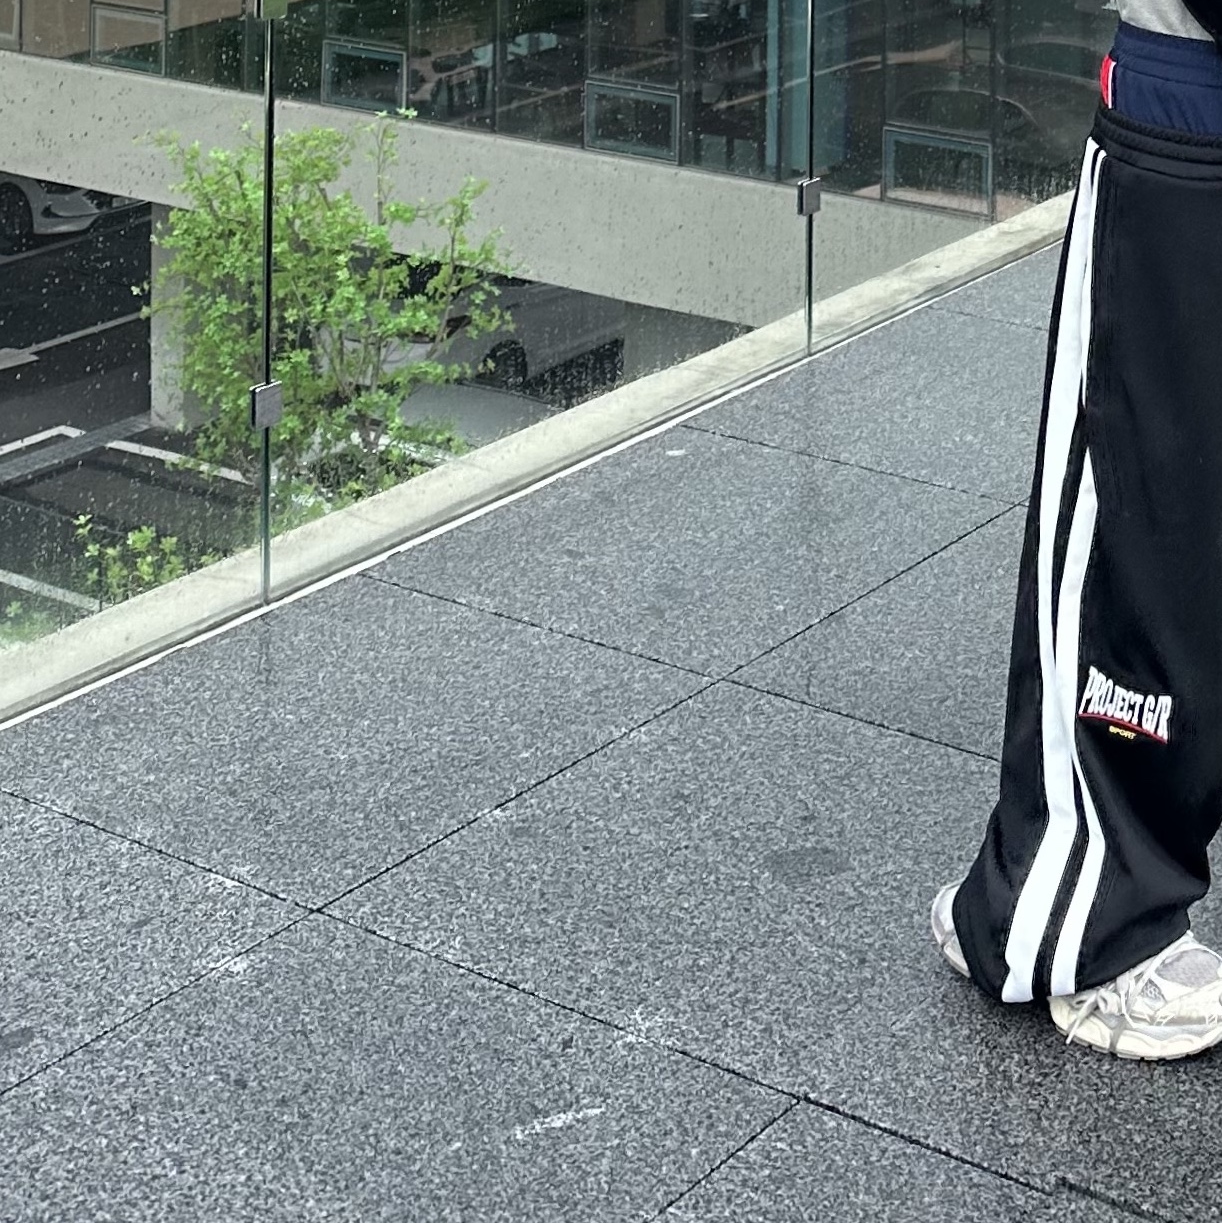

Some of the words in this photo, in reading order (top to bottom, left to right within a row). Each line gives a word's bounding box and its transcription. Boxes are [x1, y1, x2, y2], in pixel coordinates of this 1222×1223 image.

[1078, 665, 1145, 726] PROJECT
[1142, 694, 1173, 742] G/R
[1108, 725, 1137, 740] SPORT
